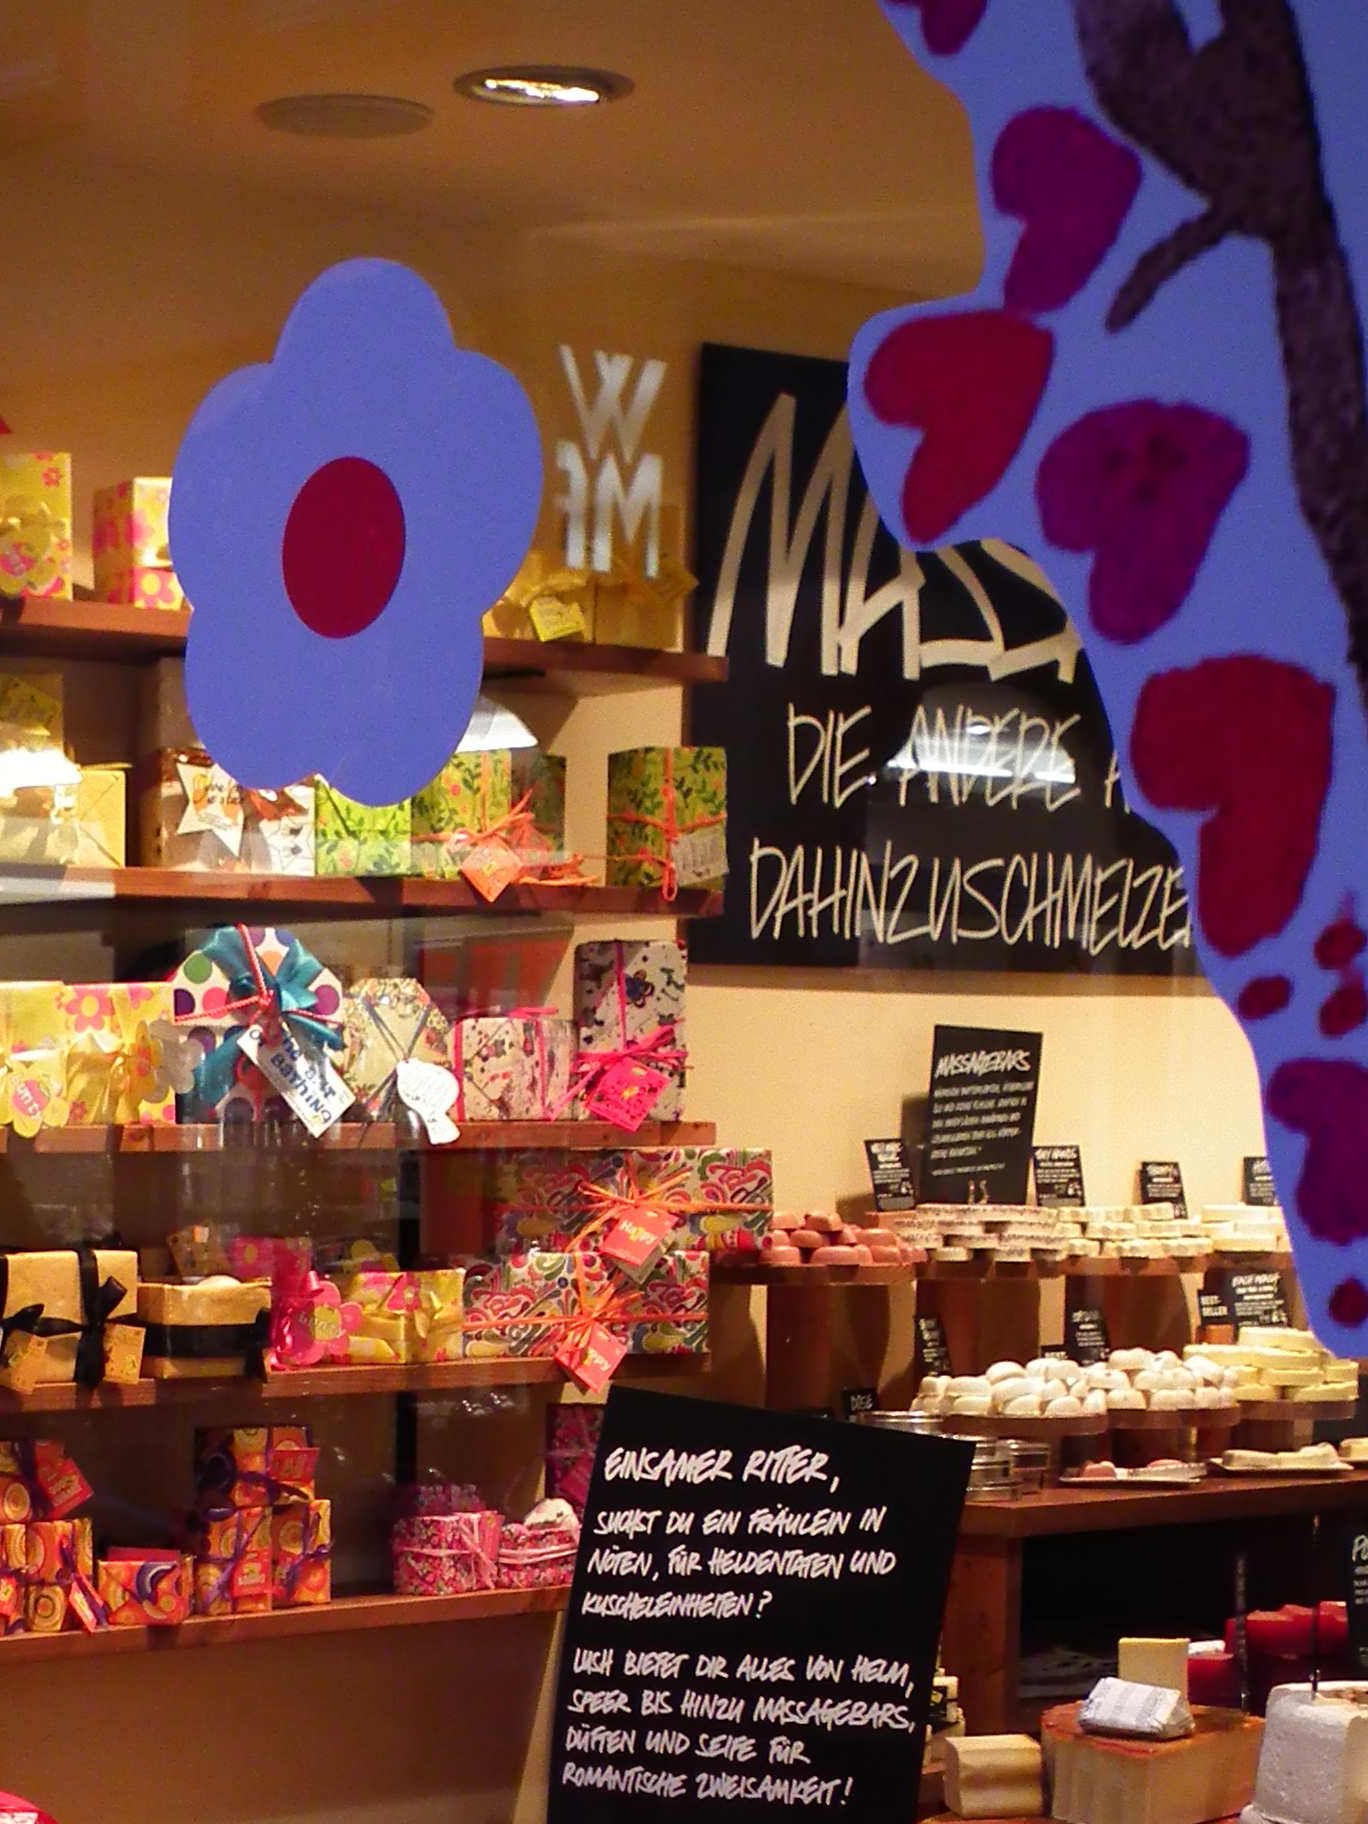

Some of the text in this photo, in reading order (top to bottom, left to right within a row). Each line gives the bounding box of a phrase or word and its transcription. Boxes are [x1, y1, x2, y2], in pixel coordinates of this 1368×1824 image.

[787, 702, 872, 809] DIE
[934, 1049, 1031, 1079] MASSAGEBARS
[604, 1444, 840, 1493] EINSAMER RITTER,
[594, 1503, 888, 1540] SUCHST DU EIN FRÄULEIN IN
[586, 1543, 897, 1581] NÖTEN, FÜR HELDENTATEN UND
[573, 1648, 915, 1698] LUSH BIETET DIR ALLES VON HELM,
[568, 1688, 918, 1734] SPEER BIS HINZU MASSAGEBARS,
[565, 1724, 812, 1766] DÜFTEN UND SEIFE FÜR
[562, 1761, 855, 1806] ROMANTISCHE ZWEISAMKEIT!
